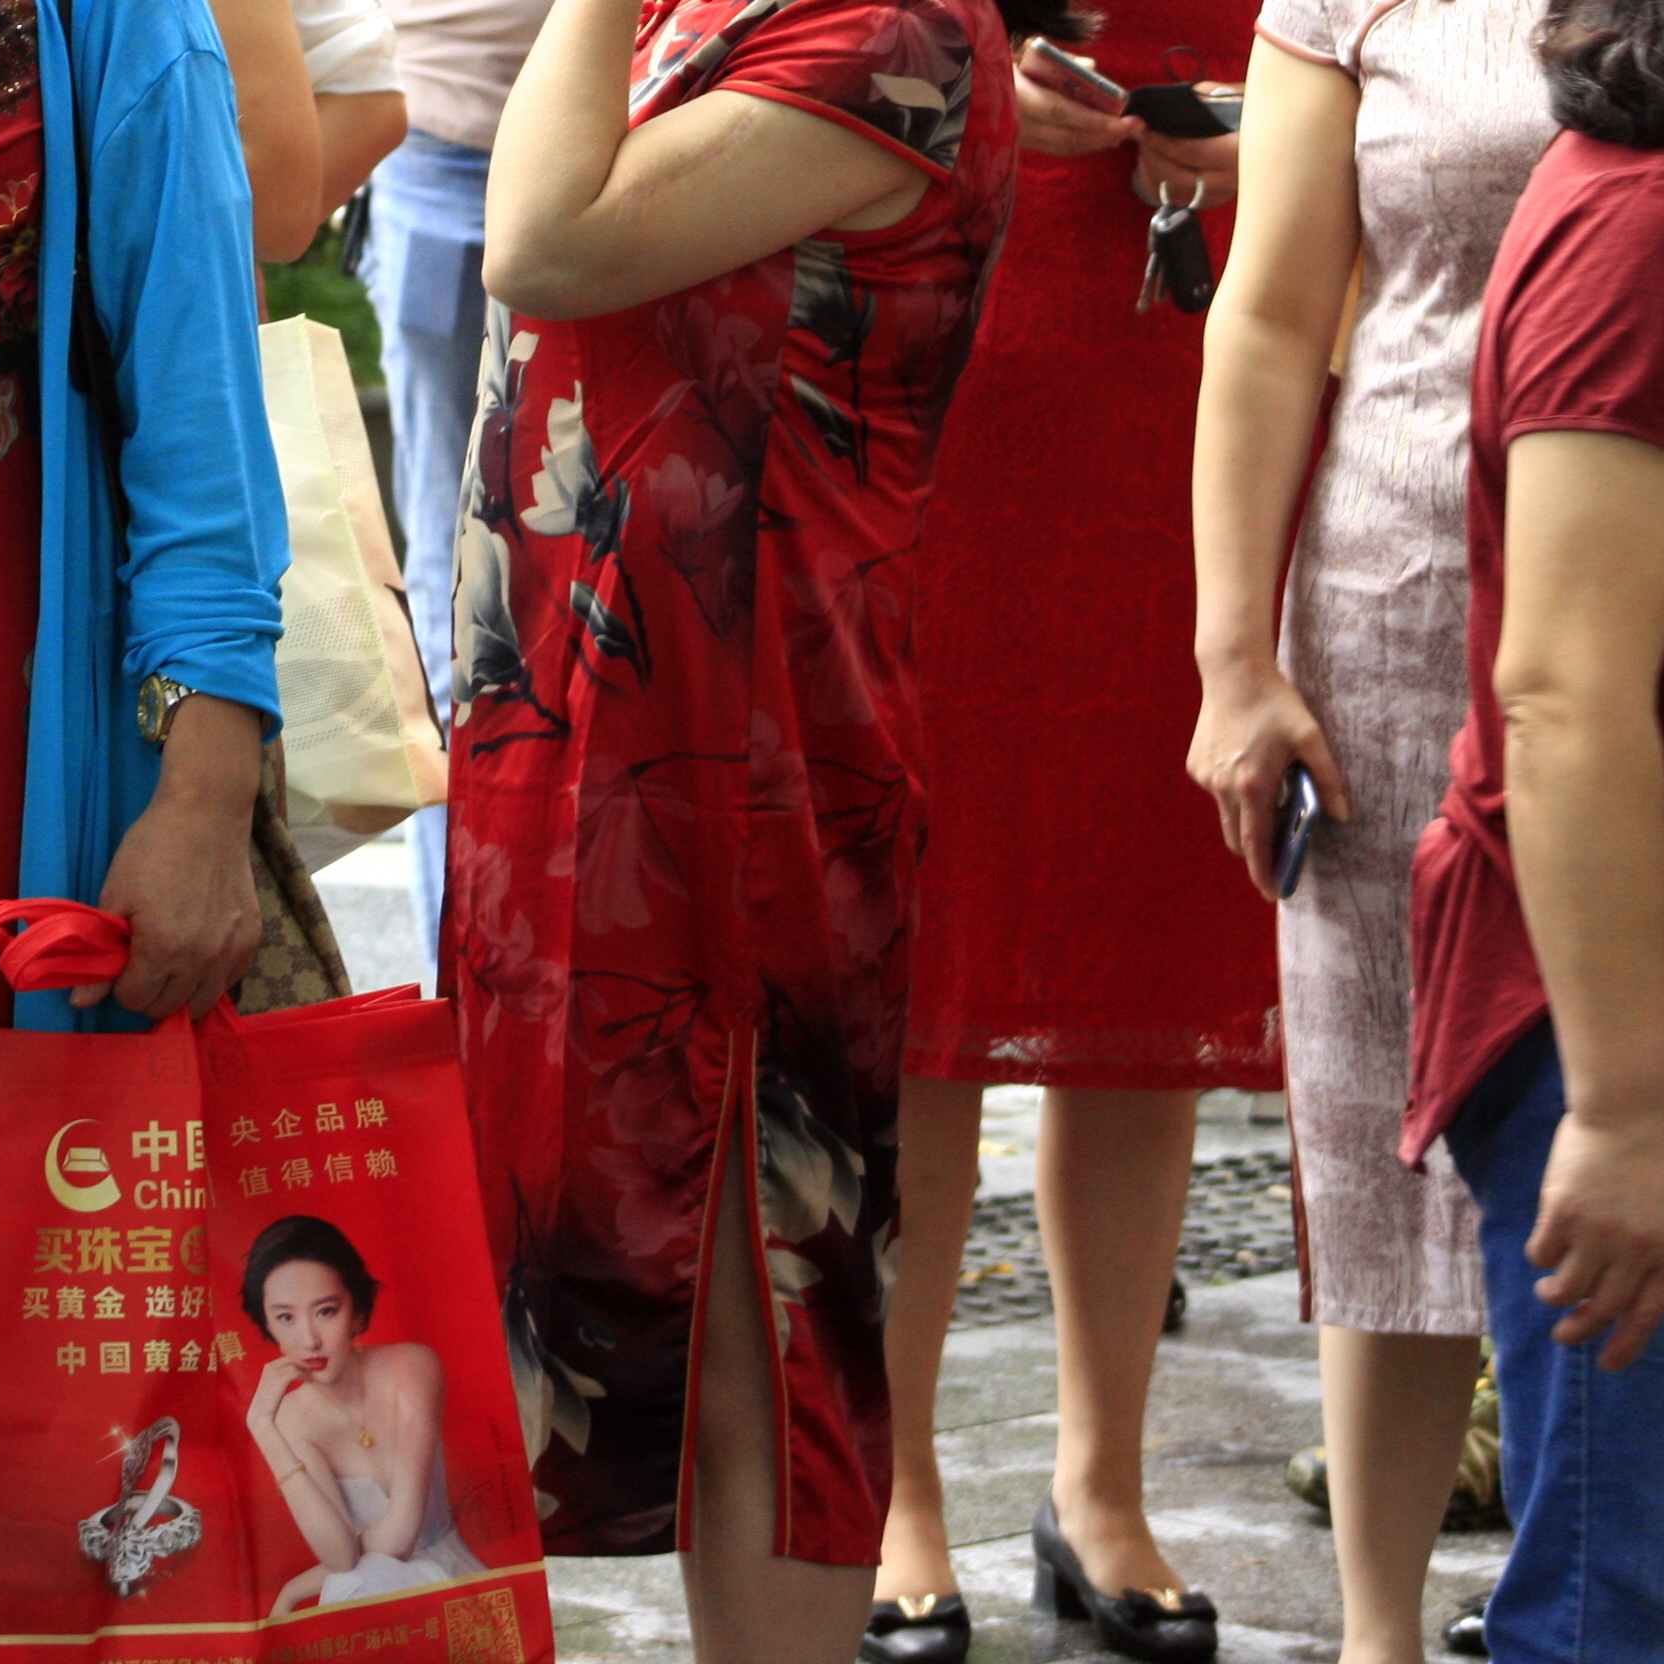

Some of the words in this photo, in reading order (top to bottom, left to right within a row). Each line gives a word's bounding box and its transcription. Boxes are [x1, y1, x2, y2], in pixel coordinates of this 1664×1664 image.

[228, 1097, 388, 1147] 央企品牌
[238, 1148, 398, 1199] 值得信赖
[21, 1285, 126, 1320] 买黄金
[145, 1285, 216, 1319] 选好
